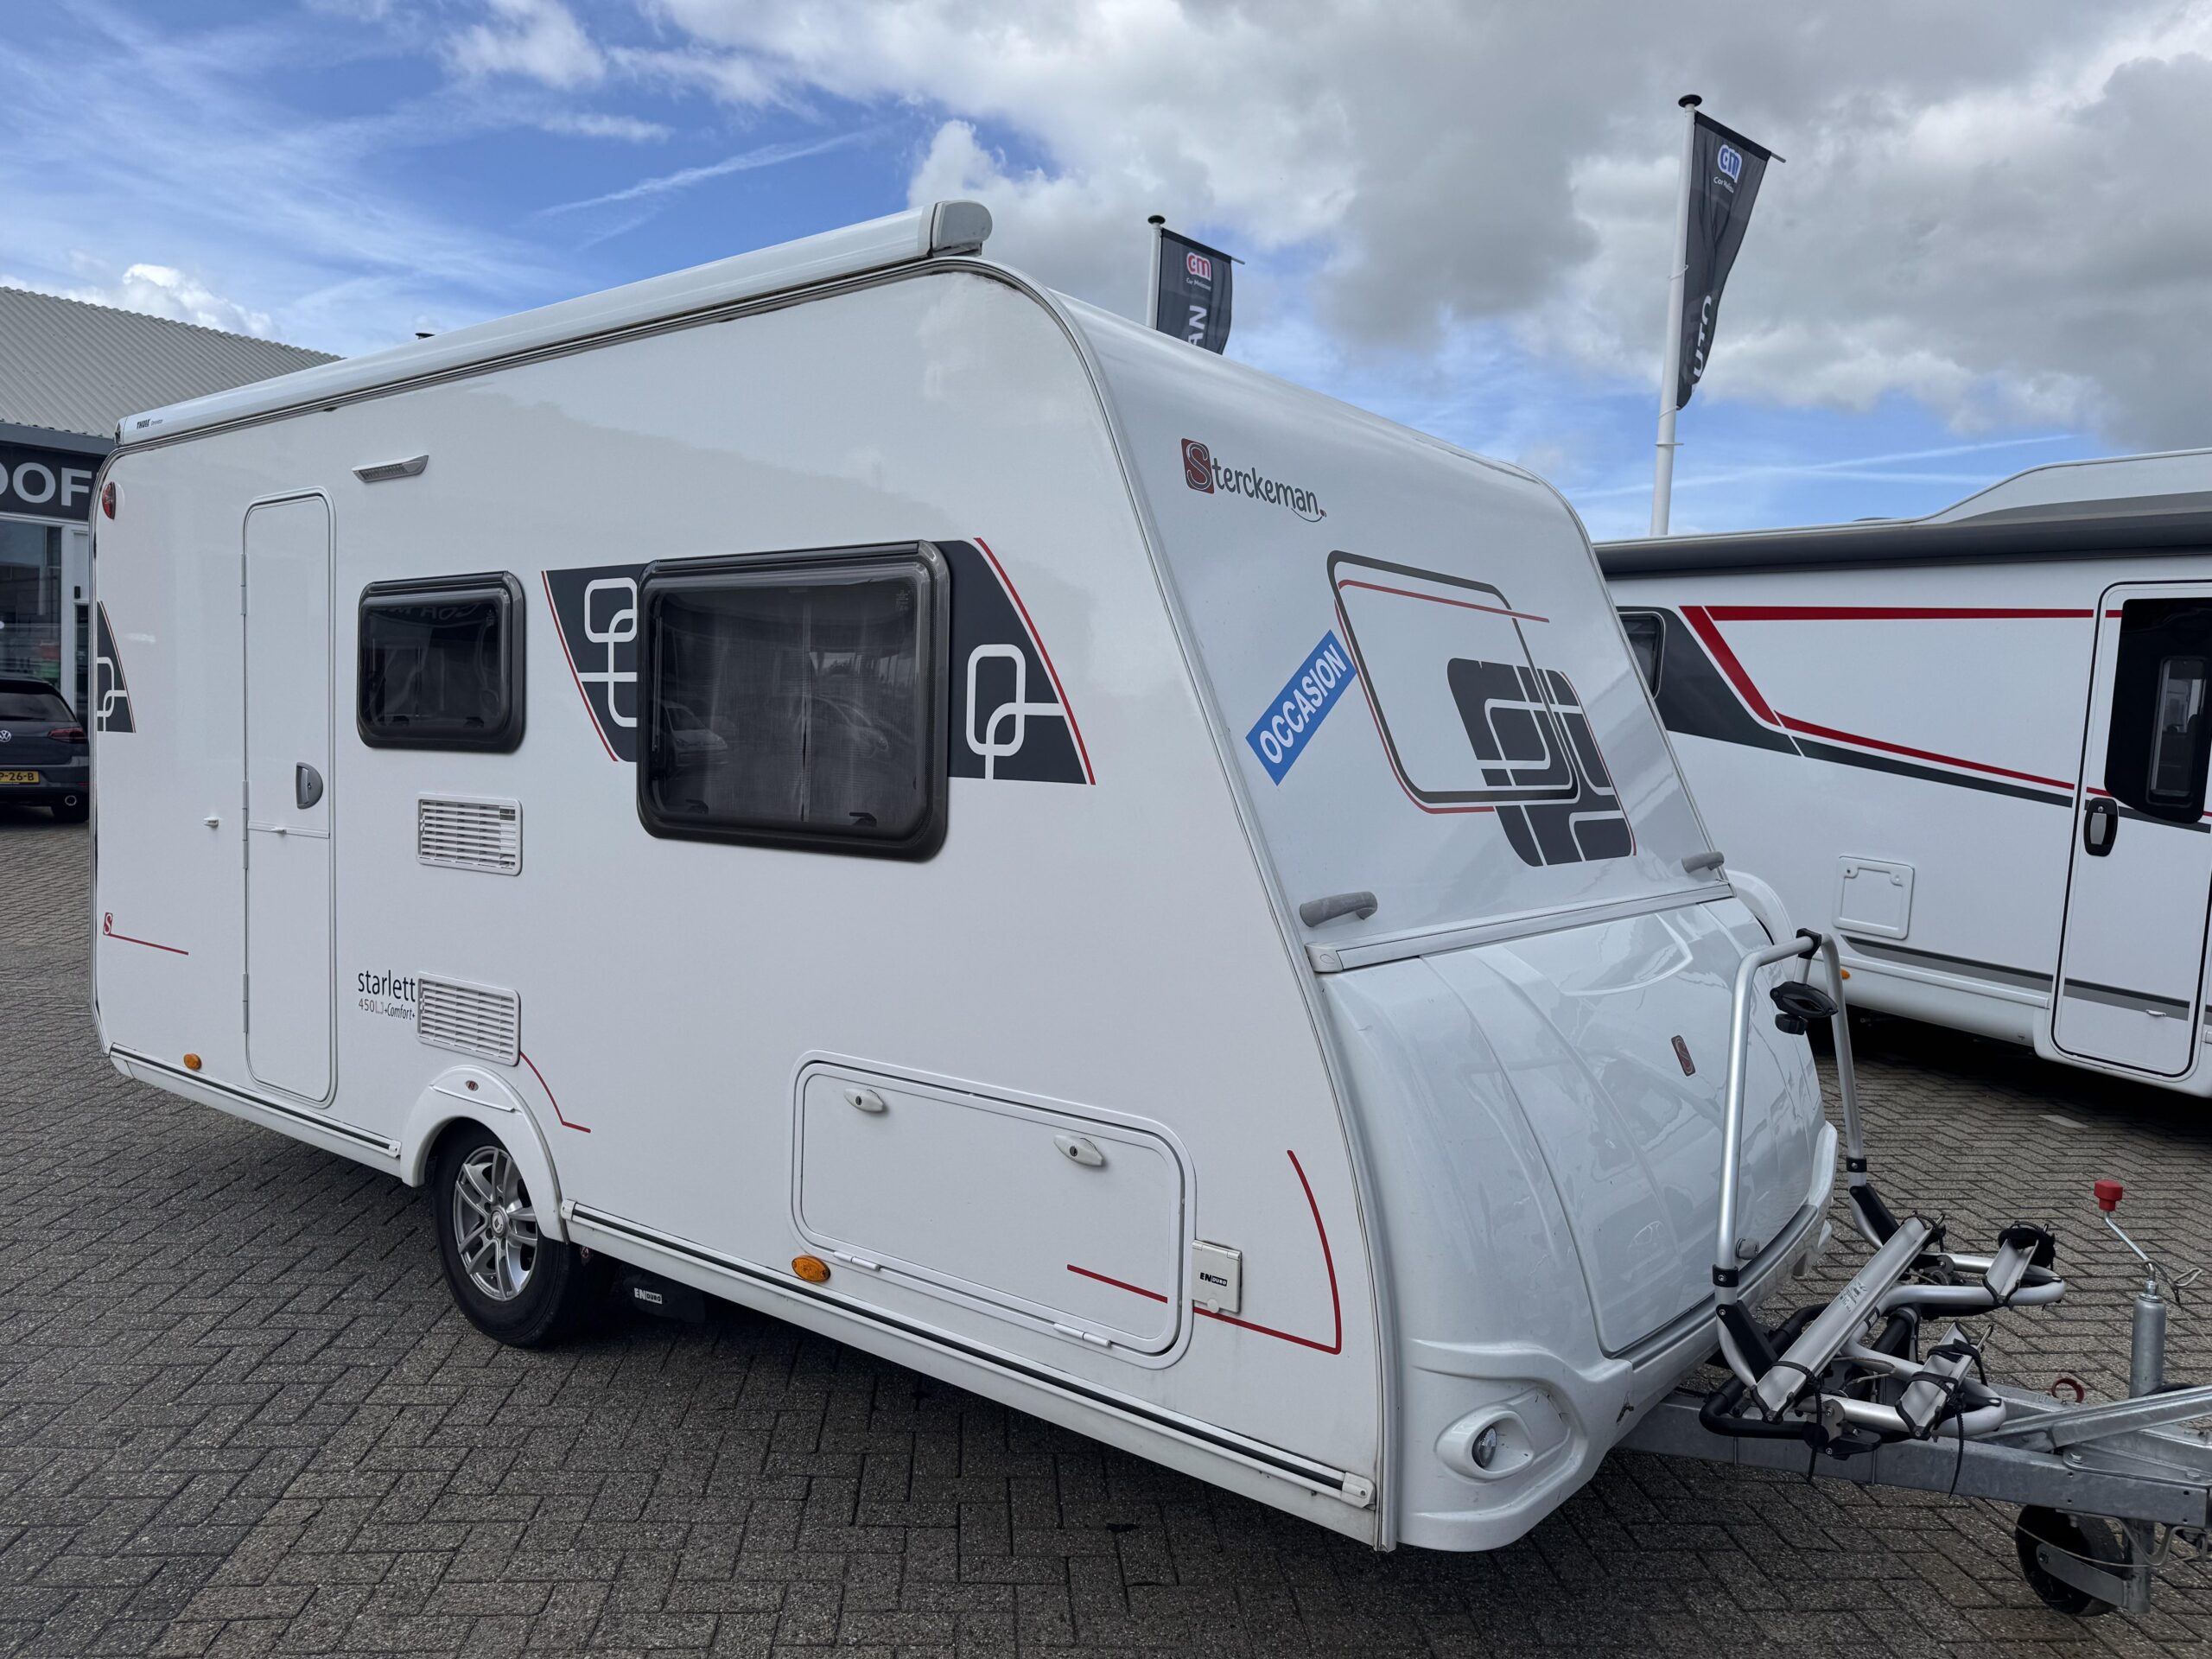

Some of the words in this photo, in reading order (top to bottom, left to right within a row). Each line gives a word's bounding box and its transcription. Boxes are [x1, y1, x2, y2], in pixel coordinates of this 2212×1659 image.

[1186, 442, 1319, 516] Sterckeman
[1260, 643, 1347, 764] OCCASION
[358, 969, 416, 1002] starlett
[634, 1287, 663, 1305] ENDURO
[1200, 1272, 1228, 1287] ENDURO
